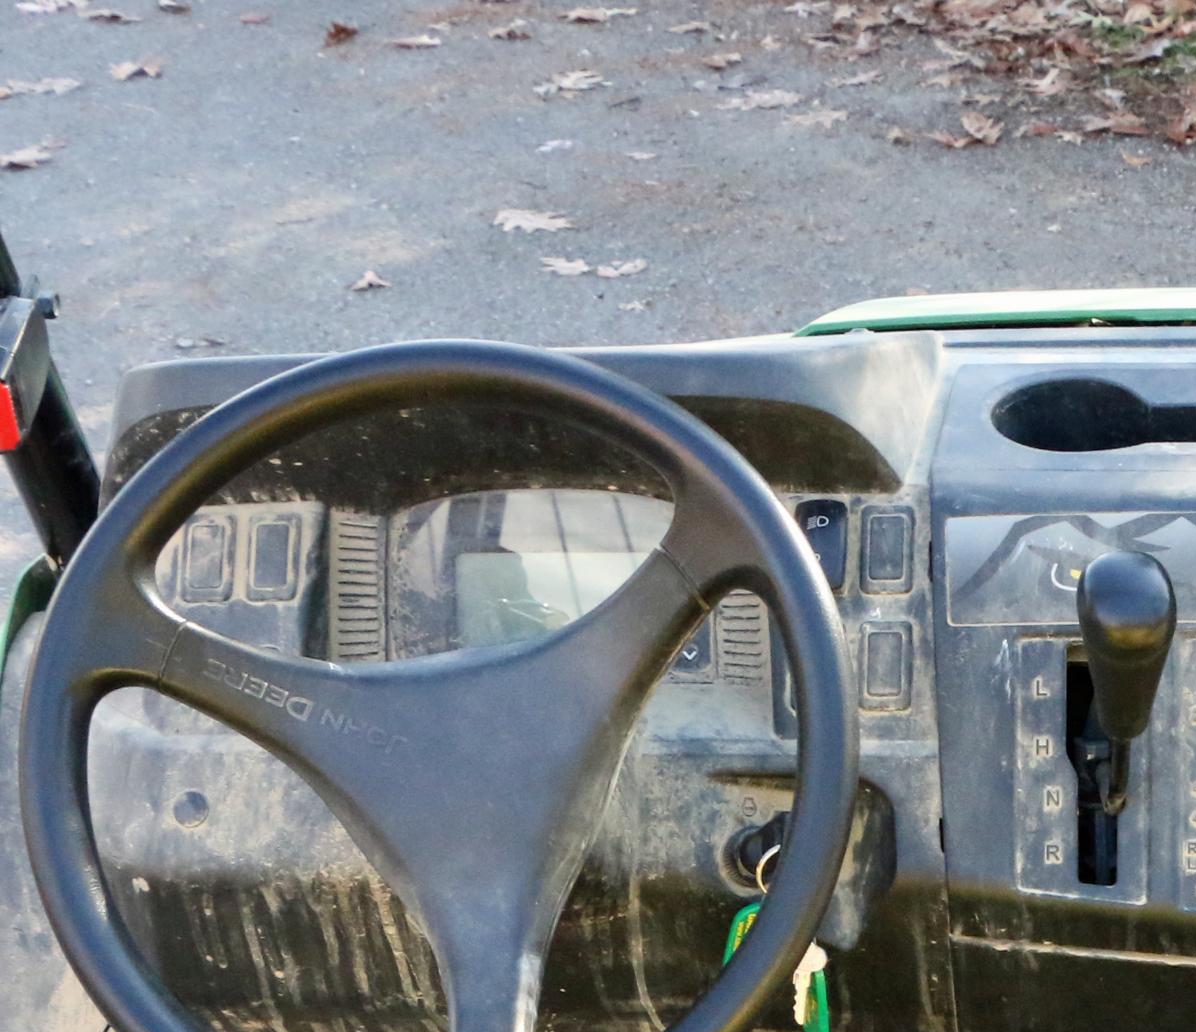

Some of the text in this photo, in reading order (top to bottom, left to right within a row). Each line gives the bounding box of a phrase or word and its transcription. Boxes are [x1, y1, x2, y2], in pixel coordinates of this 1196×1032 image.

[1036, 680, 1047, 696] L
[203, 658, 408, 754] JOHN DEERE
[1036, 739, 1049, 755] H
[1046, 790, 1060, 806] N
[1046, 844, 1060, 861] R
